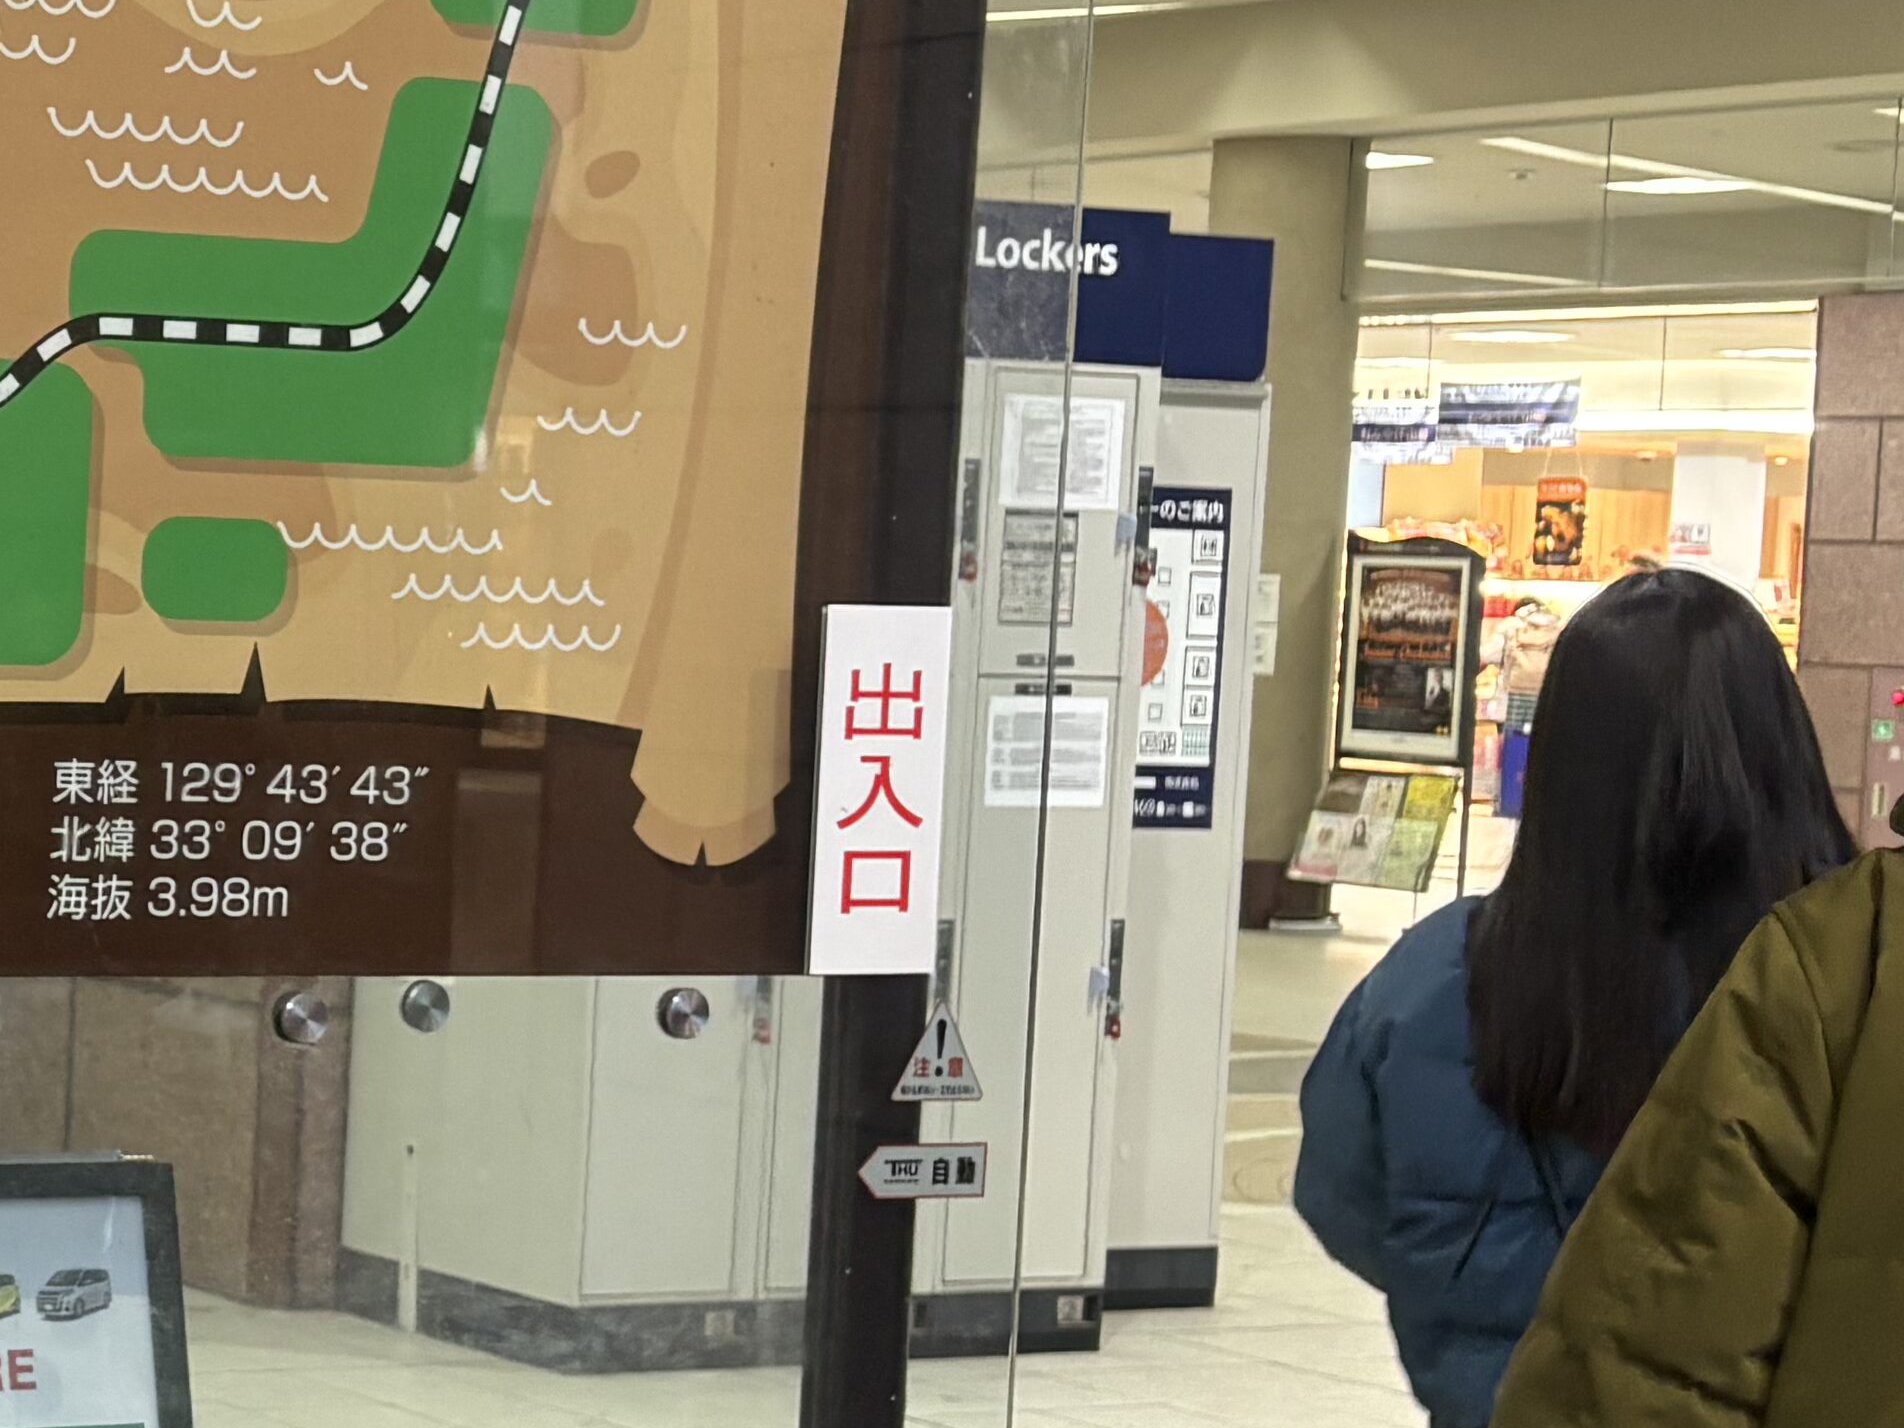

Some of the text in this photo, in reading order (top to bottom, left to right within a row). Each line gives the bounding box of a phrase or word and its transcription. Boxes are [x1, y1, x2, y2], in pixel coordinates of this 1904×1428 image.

[975, 226, 1119, 276] Lockers
[52, 758, 139, 805] 東経
[837, 662, 924, 915] 出入口
[49, 814, 136, 864] 北緯
[46, 873, 290, 921] 海抜 3.98m
